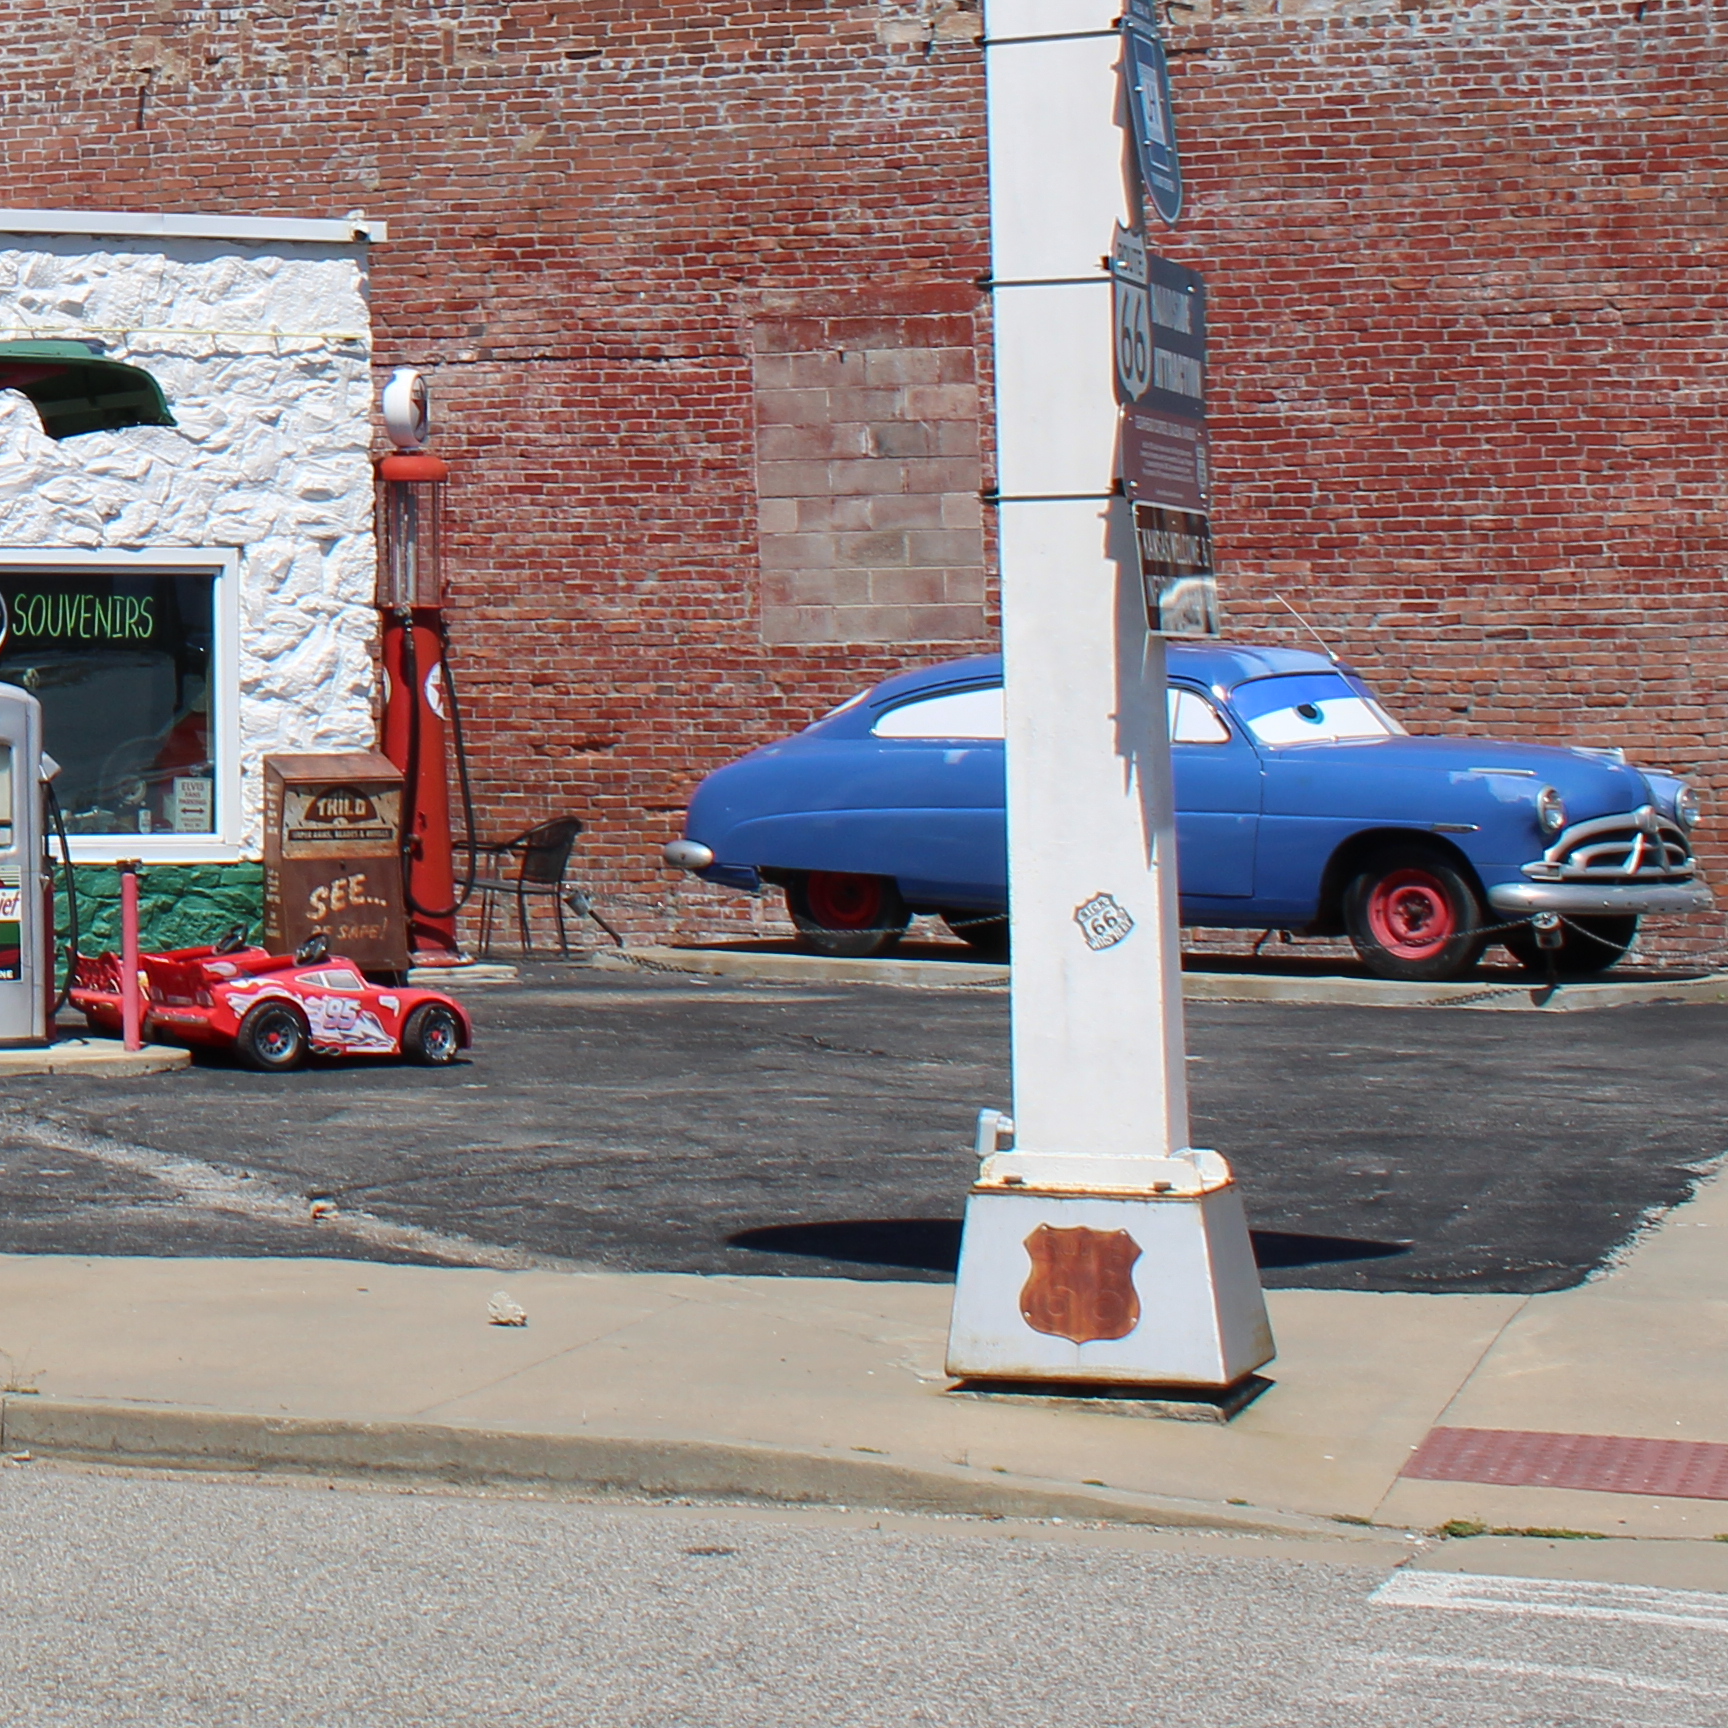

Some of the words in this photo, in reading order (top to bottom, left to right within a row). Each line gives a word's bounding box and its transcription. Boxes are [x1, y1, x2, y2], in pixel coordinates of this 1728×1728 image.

[1121, 289, 1146, 383] 66
[12, 593, 154, 639] SOUVENIRS
[181, 781, 205, 791] ELVIS
[1090, 910, 1118, 936] 66
[323, 998, 362, 1030] 95
